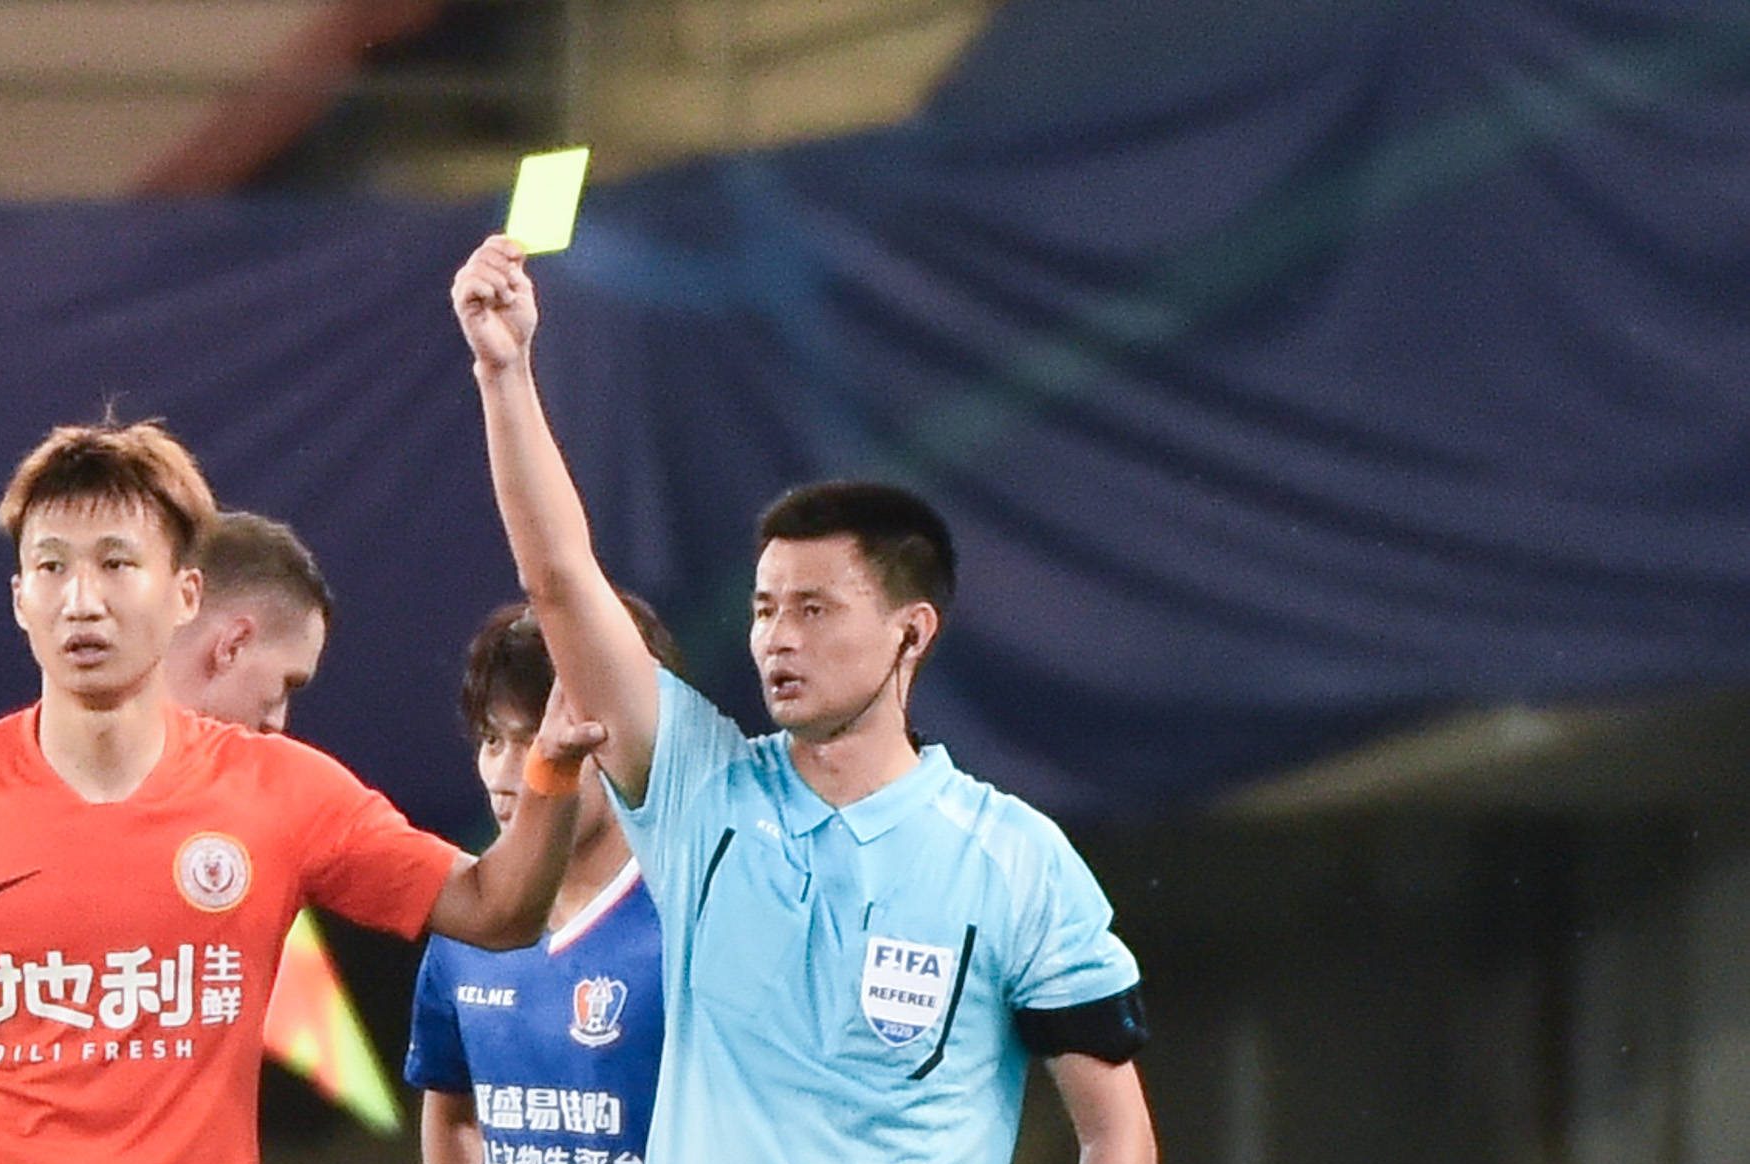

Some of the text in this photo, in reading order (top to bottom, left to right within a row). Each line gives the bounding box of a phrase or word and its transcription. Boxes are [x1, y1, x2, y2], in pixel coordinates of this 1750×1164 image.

[874, 944, 940, 979] FIFA
[457, 985, 517, 1007] KELME
[868, 985, 937, 1009] REFEREE
[881, 1021, 915, 1038] 2020
[81, 1038, 193, 1061] FRESH
